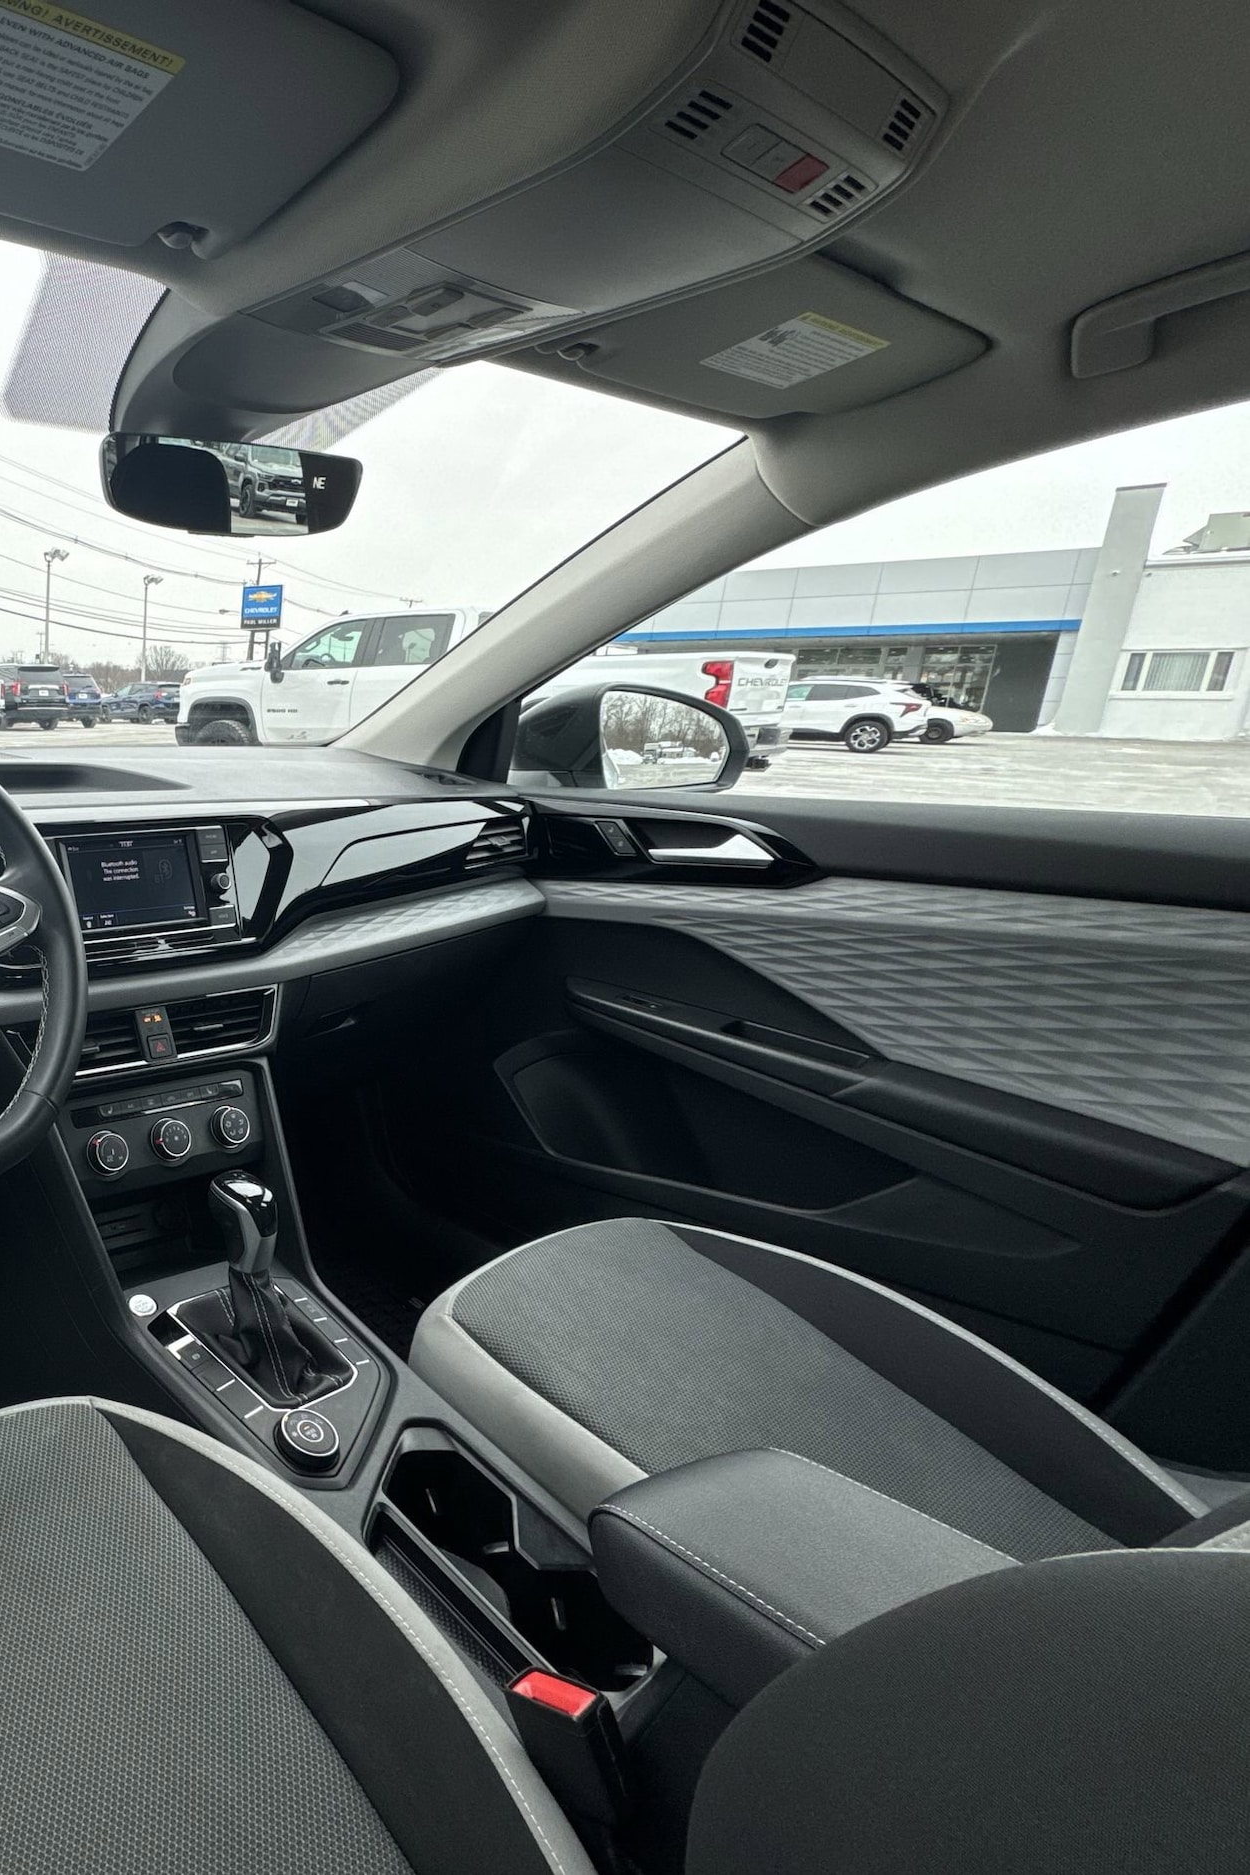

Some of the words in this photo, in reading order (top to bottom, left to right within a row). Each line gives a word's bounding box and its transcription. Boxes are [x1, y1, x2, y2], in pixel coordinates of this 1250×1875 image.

[26, 26, 55, 42] WITH
[54, 37, 107, 63] ADVANCED
[104, 58, 125, 70] AIR
[122, 65, 150, 79] BAGS
[51, 12, 174, 67] AVERTISSEMENT!
[313, 477, 327, 490] NE
